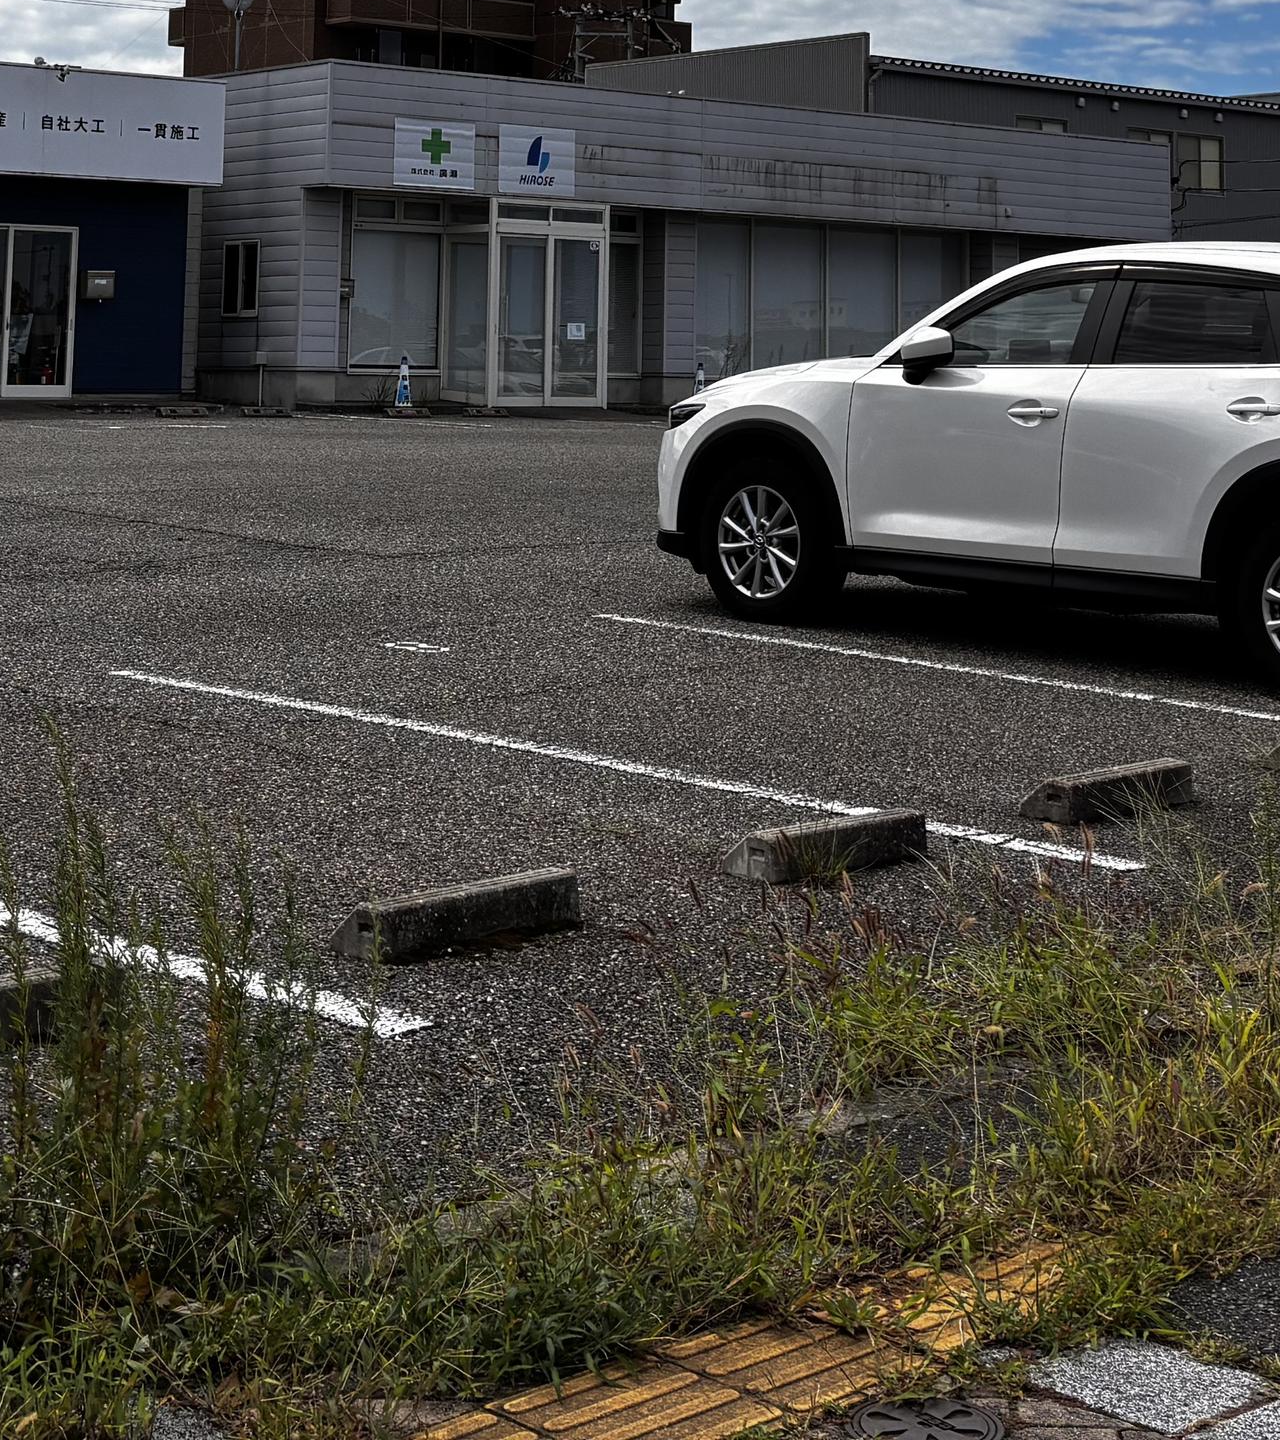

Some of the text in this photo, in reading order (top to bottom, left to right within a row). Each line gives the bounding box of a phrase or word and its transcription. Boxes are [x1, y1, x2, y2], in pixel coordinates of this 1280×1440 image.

[41, 114, 105, 133] 自社大工
[137, 123, 200, 141] 一貫施工
[519, 174, 556, 187] HIROSE
